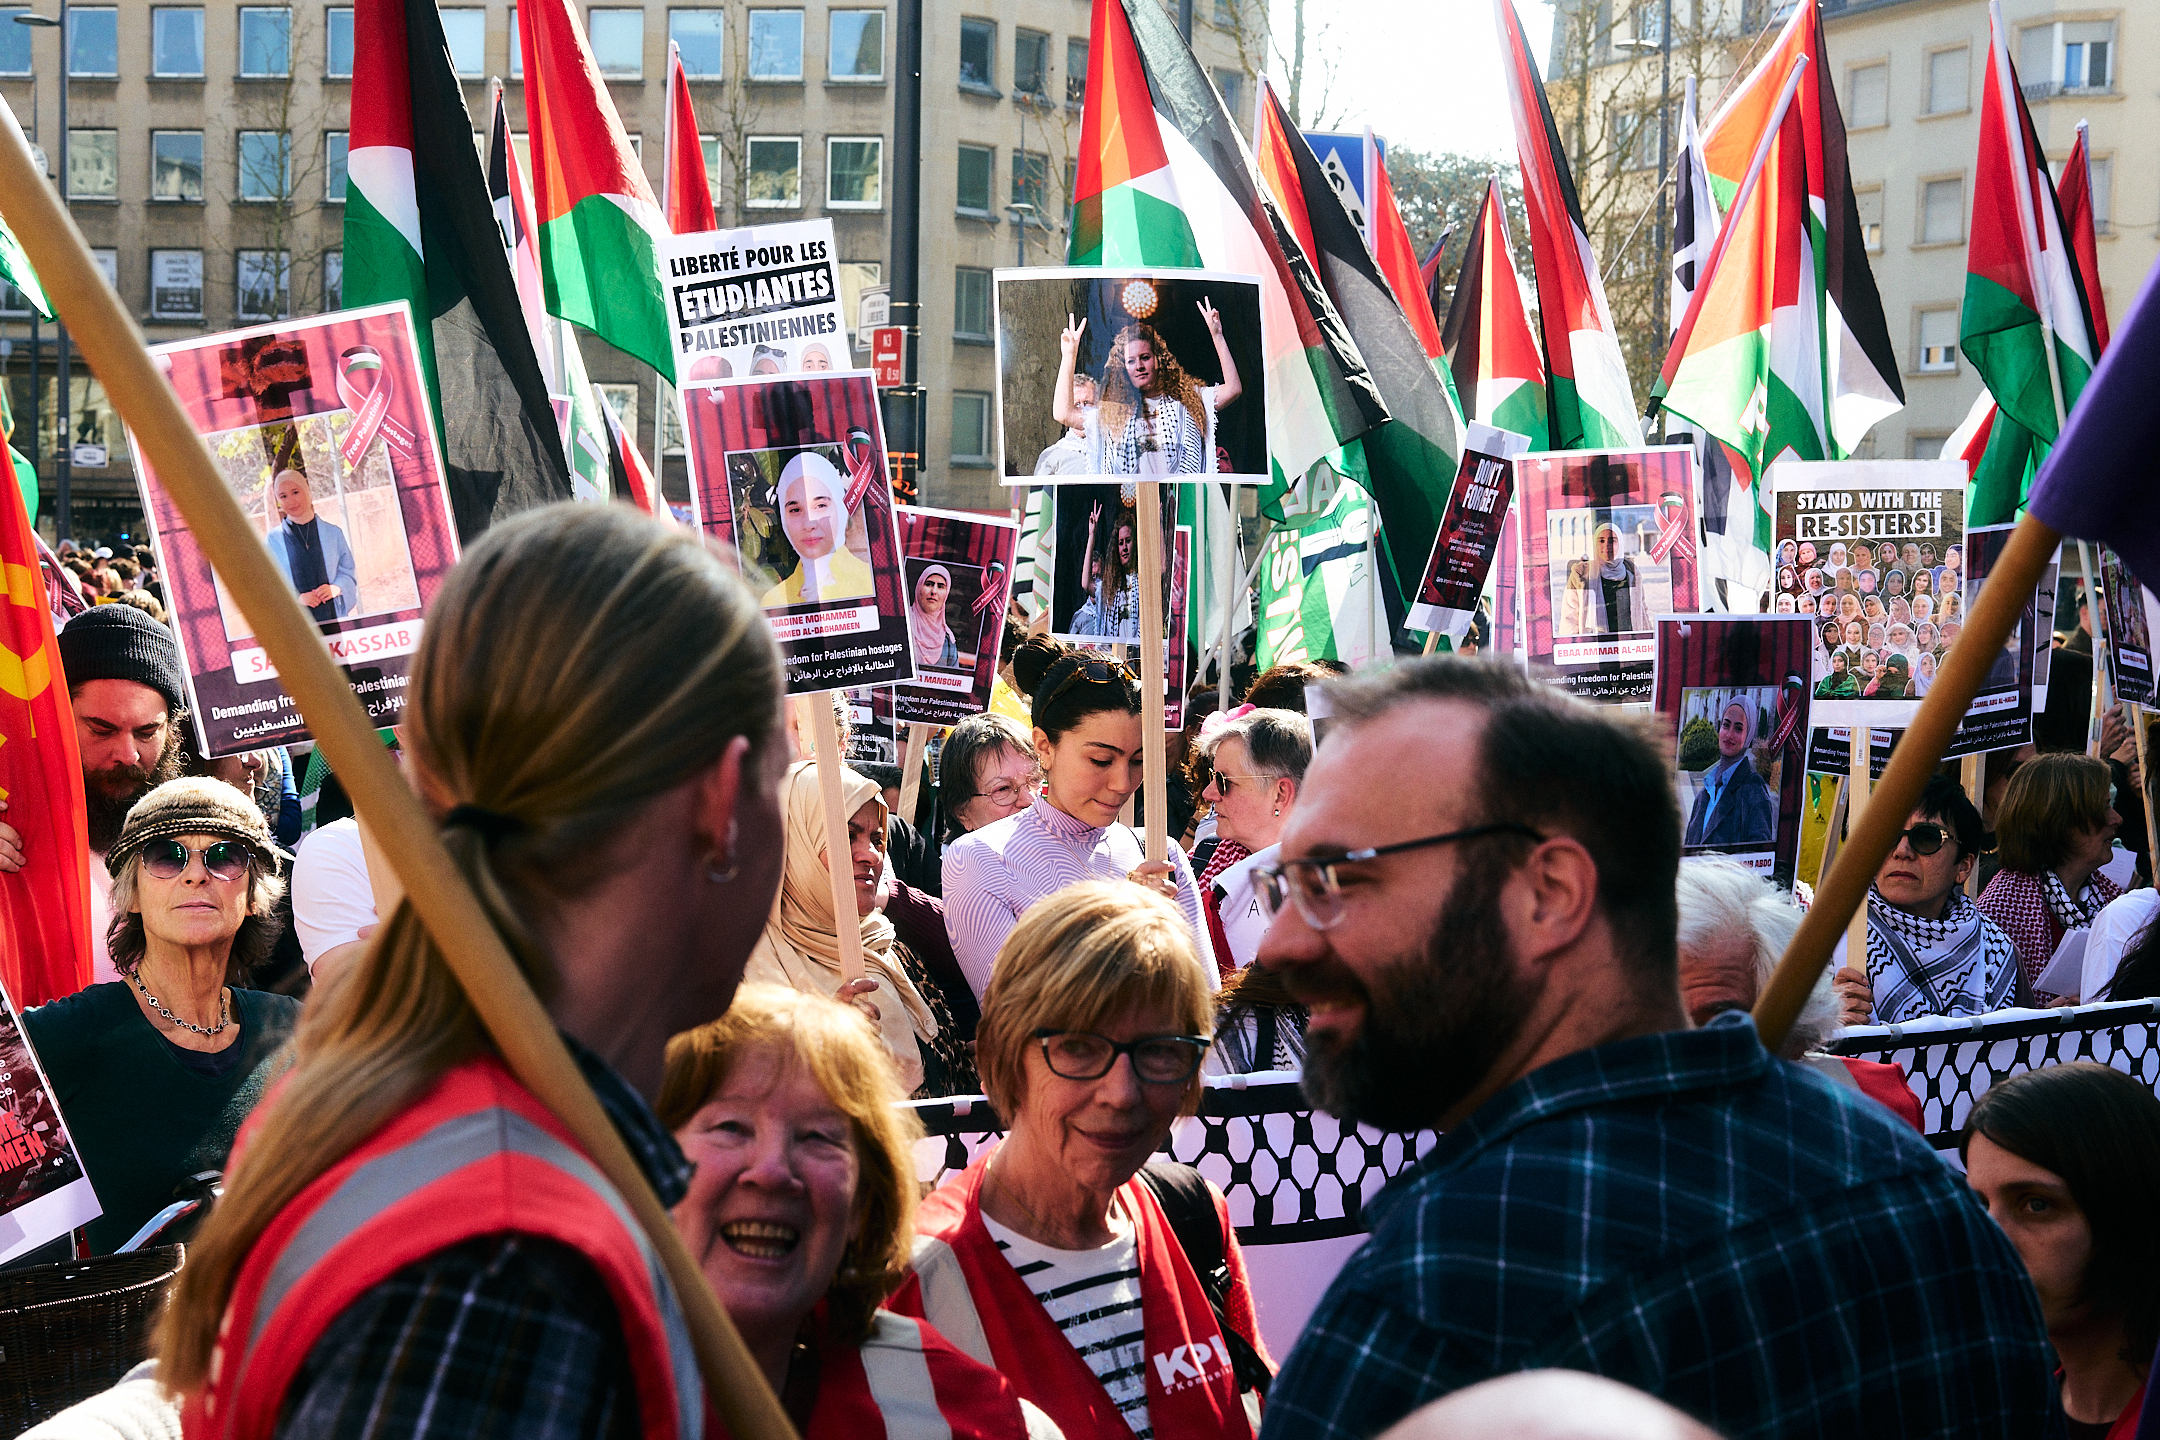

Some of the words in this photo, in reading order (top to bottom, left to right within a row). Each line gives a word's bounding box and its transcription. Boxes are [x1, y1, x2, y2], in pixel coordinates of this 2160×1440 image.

[670, 246, 740, 277] LIBERTÉ
[745, 245, 794, 268] POUR
[800, 240, 827, 261] LES
[678, 268, 831, 321] ÉTUDIANTES
[681, 312, 837, 354] PALESTINIENNES
[345, 438, 361, 459] Free
[357, 391, 384, 439] Palestinian
[380, 421, 412, 450] Hostages
[1473, 458, 1505, 488] DON'T
[1462, 483, 1499, 514] FORGET
[1797, 492, 1853, 510] STAND
[1859, 491, 1904, 509] WITH
[1910, 491, 1942, 508] THE
[1802, 511, 1936, 538] RE-SISTERS!
[1652, 546, 1663, 559] Free
[772, 616, 804, 628] NADINE
[805, 610, 857, 624] MOHAMMED
[802, 621, 860, 636] AL-DAGHAMEEN
[328, 630, 411, 658] KASSAB
[811, 652, 823, 662] for
[824, 647, 868, 660] Palestinian
[868, 643, 903, 656] hostages
[1557, 649, 1580, 658] EBAA
[1583, 647, 1619, 657] AMMAR
[822, 668, 835, 679] عن
[864, 659, 895, 673] للمطالبة
[924, 676, 962, 687] MANSOUR
[1577, 674, 1607, 683] freedom
[1610, 673, 1620, 682] for
[1622, 671, 1655, 681] Palestini
[211, 698, 278, 720] Demanding
[959, 701, 984, 712] hostages
[1833, 729, 1846, 737] RUBA
[1813, 746, 1836, 757] Demanding
[1755, 858, 1772, 868] ABDO
[0, 1130, 47, 1174] MEN
